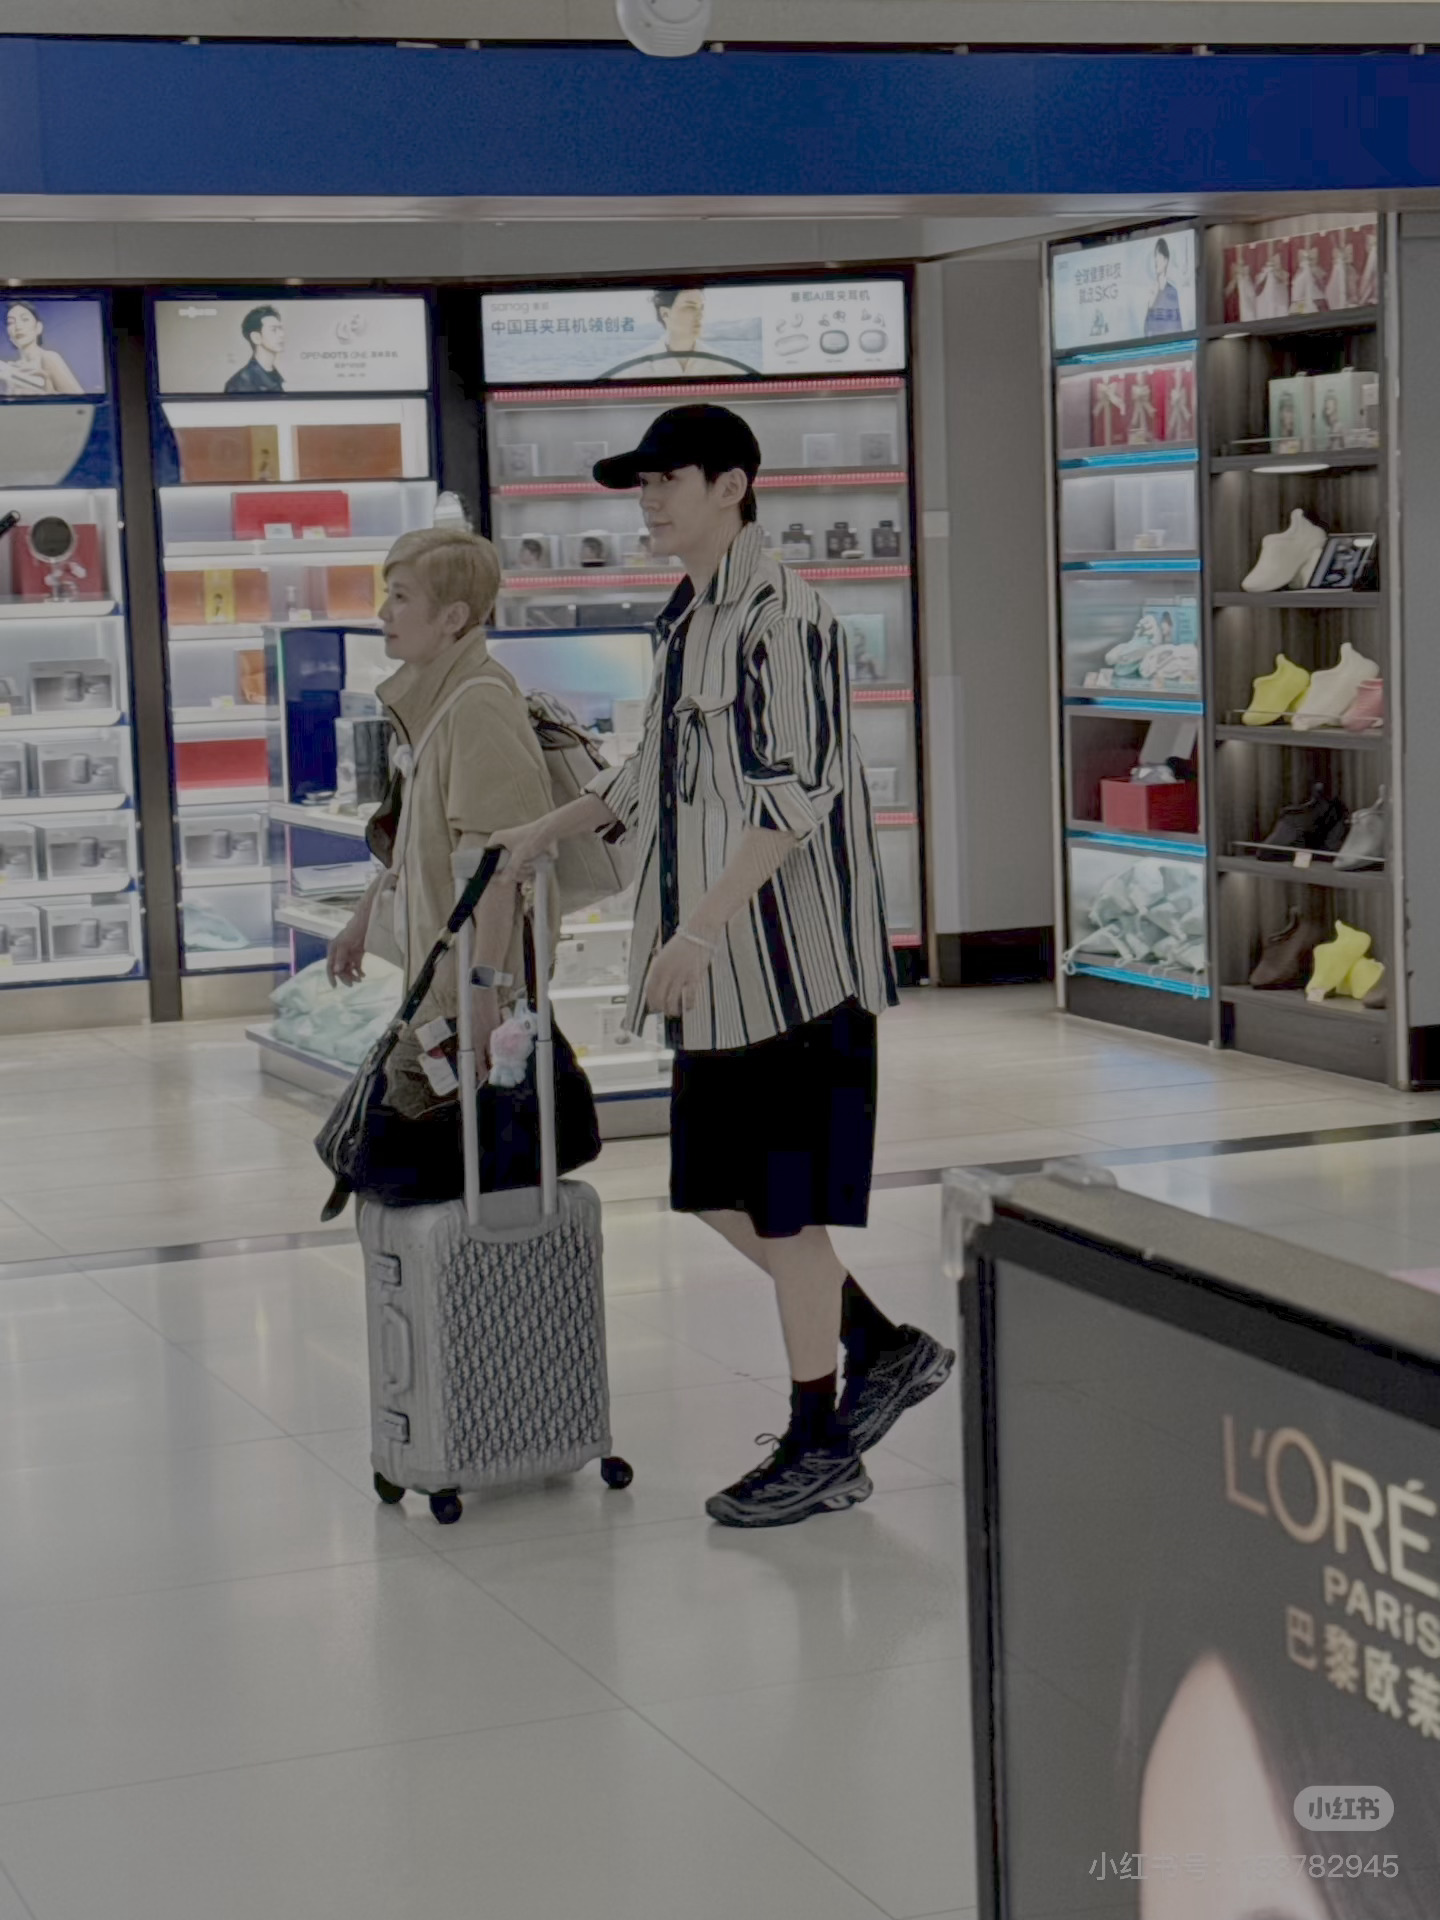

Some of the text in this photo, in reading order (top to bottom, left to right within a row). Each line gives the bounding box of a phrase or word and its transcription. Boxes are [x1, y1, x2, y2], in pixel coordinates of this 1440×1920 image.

[491, 316, 635, 336] 中国耳夹耳机领创者
